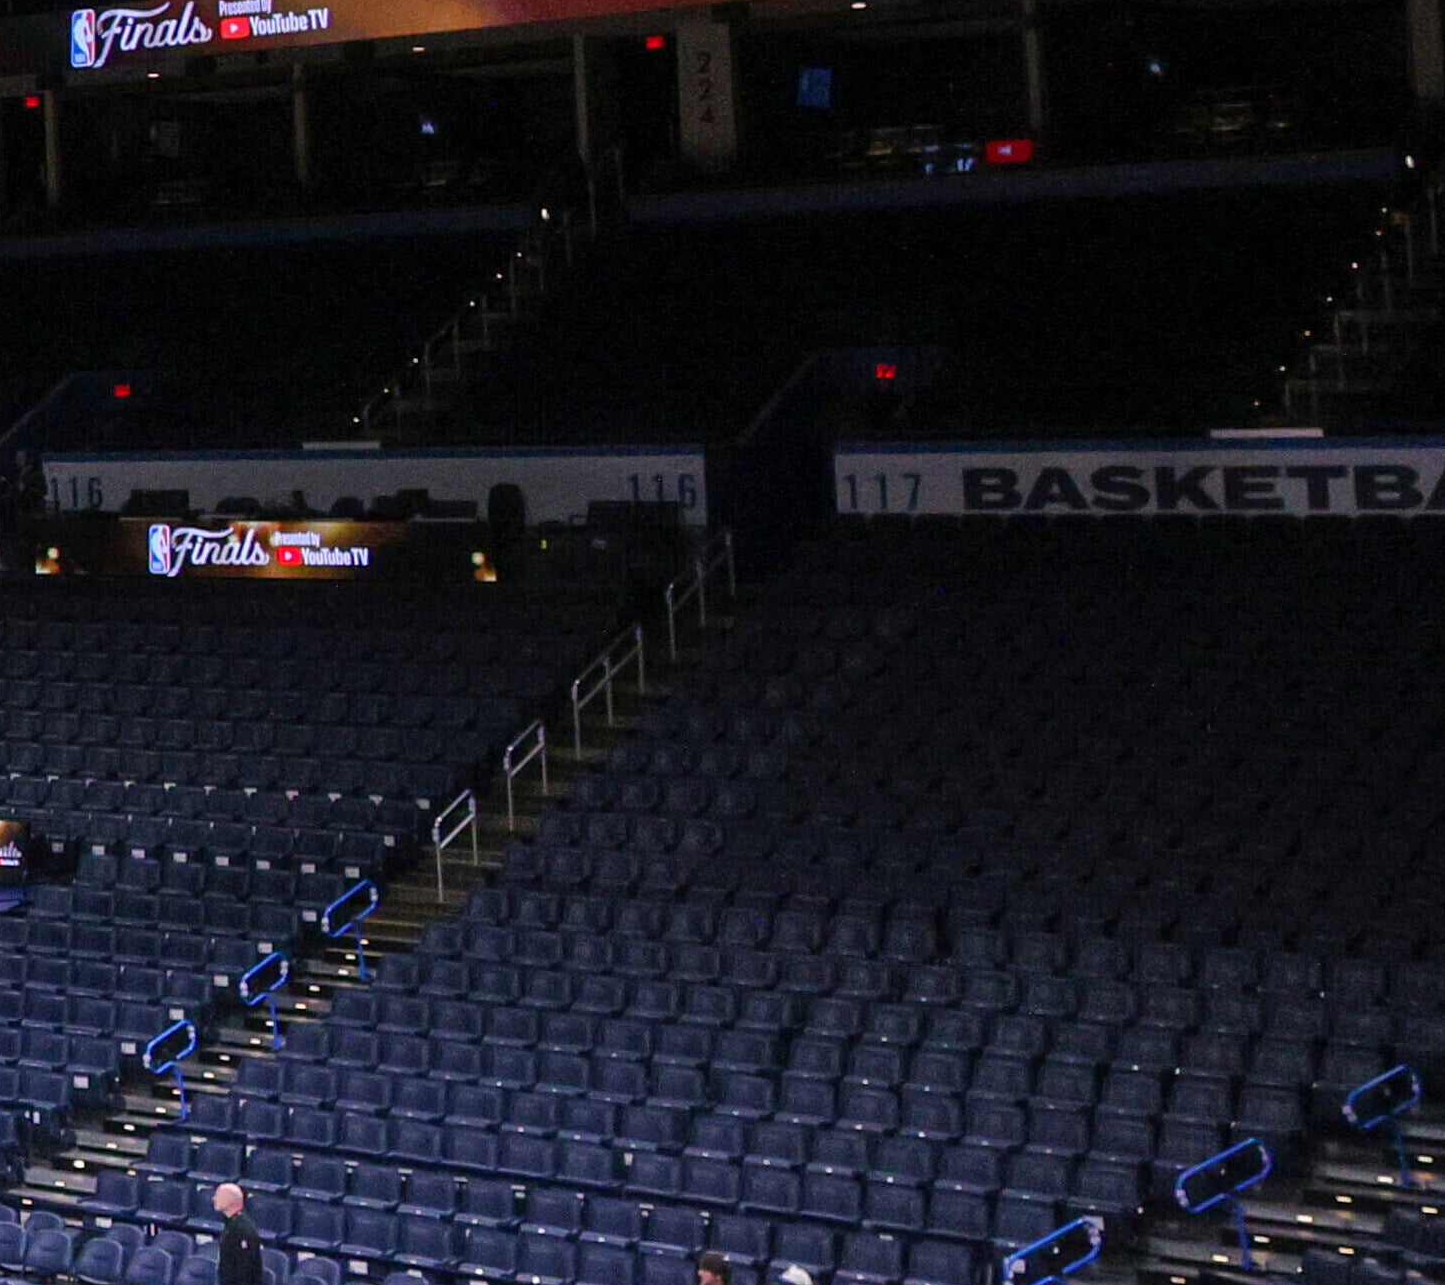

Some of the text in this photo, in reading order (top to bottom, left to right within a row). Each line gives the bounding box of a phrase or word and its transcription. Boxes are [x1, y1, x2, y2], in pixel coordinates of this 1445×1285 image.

[92, 0, 213, 69] Finals
[250, 7, 330, 36] YouTube TV
[50, 476, 104, 511] 116
[629, 472, 696, 512] 116
[845, 472, 923, 513] 117
[167, 526, 270, 578] Finals
